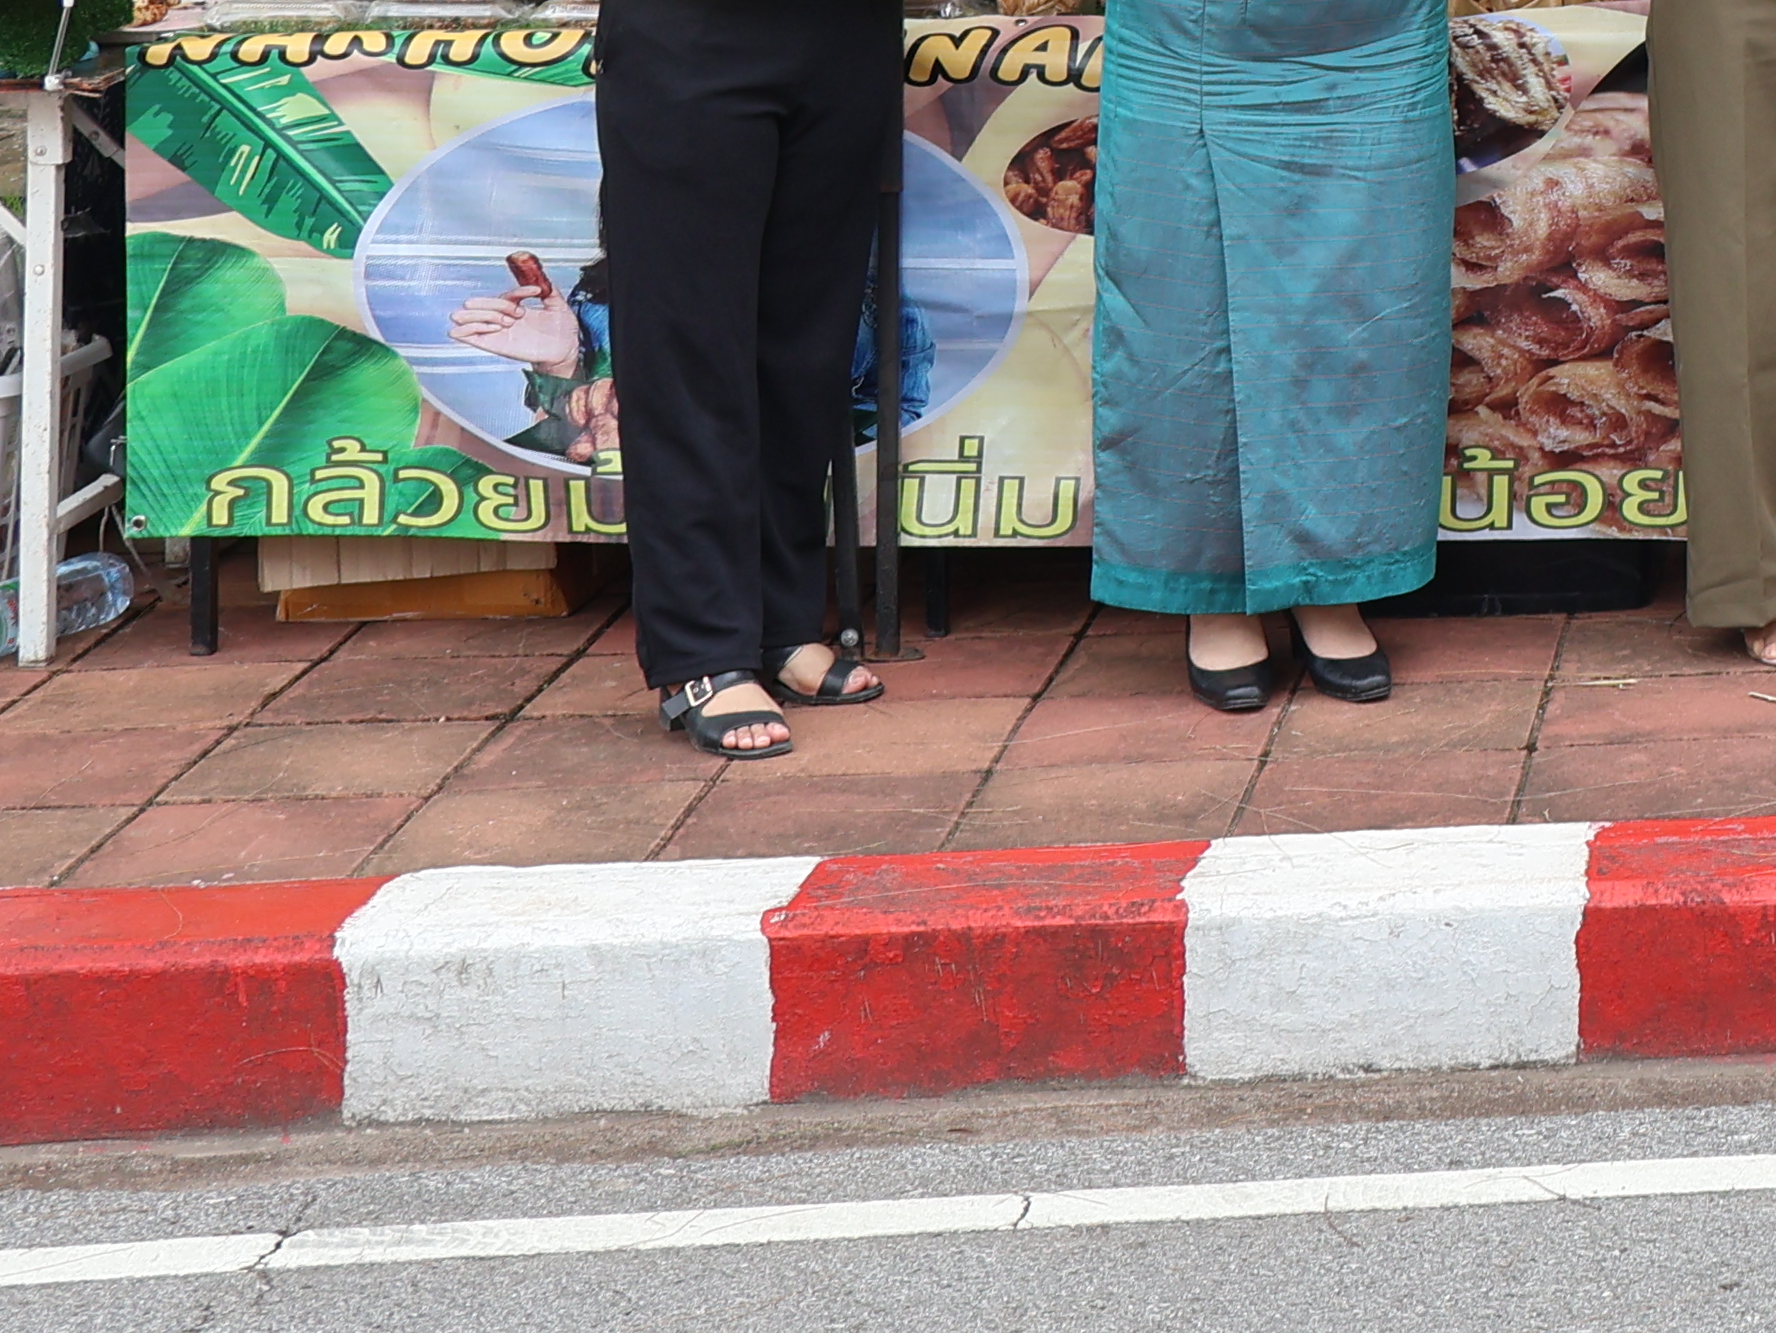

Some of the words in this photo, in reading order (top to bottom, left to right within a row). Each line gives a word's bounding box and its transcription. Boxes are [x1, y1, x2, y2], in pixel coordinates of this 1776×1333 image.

[143, 29, 596, 75] NAKHO
[206, 436, 628, 536] กล้วยม้
